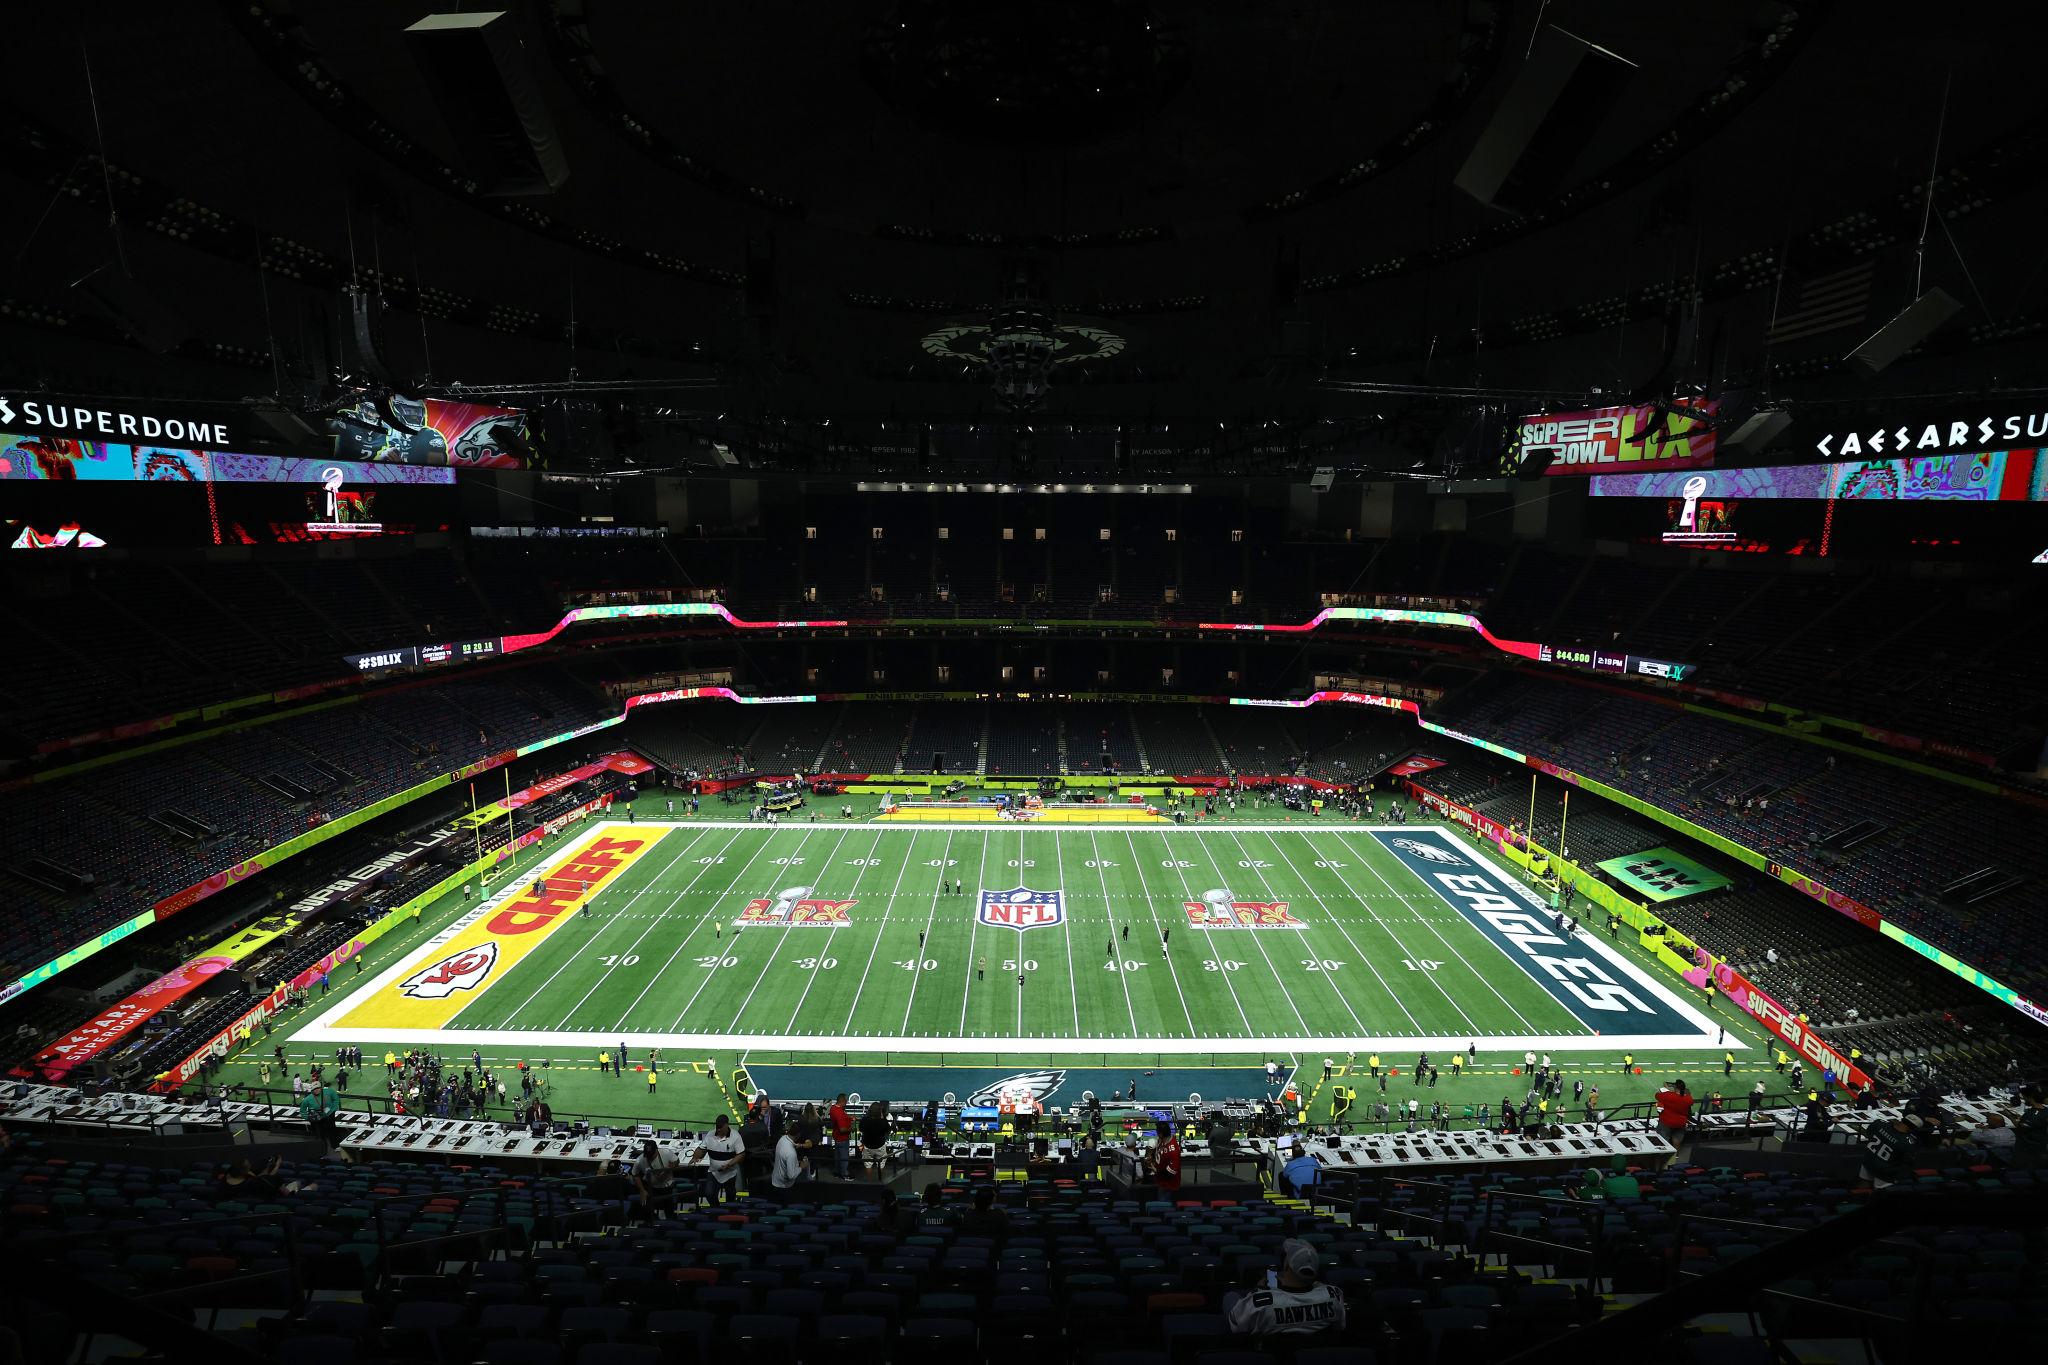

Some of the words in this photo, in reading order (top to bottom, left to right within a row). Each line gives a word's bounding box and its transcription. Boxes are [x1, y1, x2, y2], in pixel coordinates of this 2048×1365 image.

[23, 401, 230, 444] SUPERDOME
[1521, 416, 1620, 445] SUPER
[1618, 410, 1699, 462] LIX
[1817, 416, 1996, 457] CAESARS
[358, 652, 402, 670] #SBLIX
[680, 688, 700, 699] LIX
[1383, 697, 1403, 709] LIX
[290, 879, 359, 913] SUPER
[348, 849, 415, 881] BOWL
[411, 828, 456, 853] LIX
[1624, 859, 1701, 892] LIX
[1769, 864, 1782, 877] 17
[486, 836, 645, 935] CHIEFS
[429, 932, 448, 945] IT
[449, 904, 493, 933] TAKES
[490, 885, 518, 905] ALL
[988, 904, 1054, 924] NFL
[1433, 872, 1657, 1014] EAGLES
[421, 953, 489, 985] KC
[603, 954, 640, 967] 10
[698, 955, 739, 968] 20
[800, 957, 838, 970] 30
[901, 958, 938, 971] 40
[1002, 958, 1039, 971] 50
[1103, 959, 1140, 972] 40
[1203, 959, 1240, 972] 30
[1301, 958, 1339, 971] 20
[1402, 958, 1439, 971] 10
[41, 1003, 136, 1059] AESARS
[66, 1007, 152, 1061] SUPERDOME
[1748, 991, 1802, 1046] SUPER
[1803, 1033, 1851, 1085] BOWL
[181, 1033, 232, 1082] SUPER
[231, 1006, 273, 1043] BOWL
[1867, 1134, 1893, 1161] 26
[1274, 1301, 1336, 1324] DAWKINS
